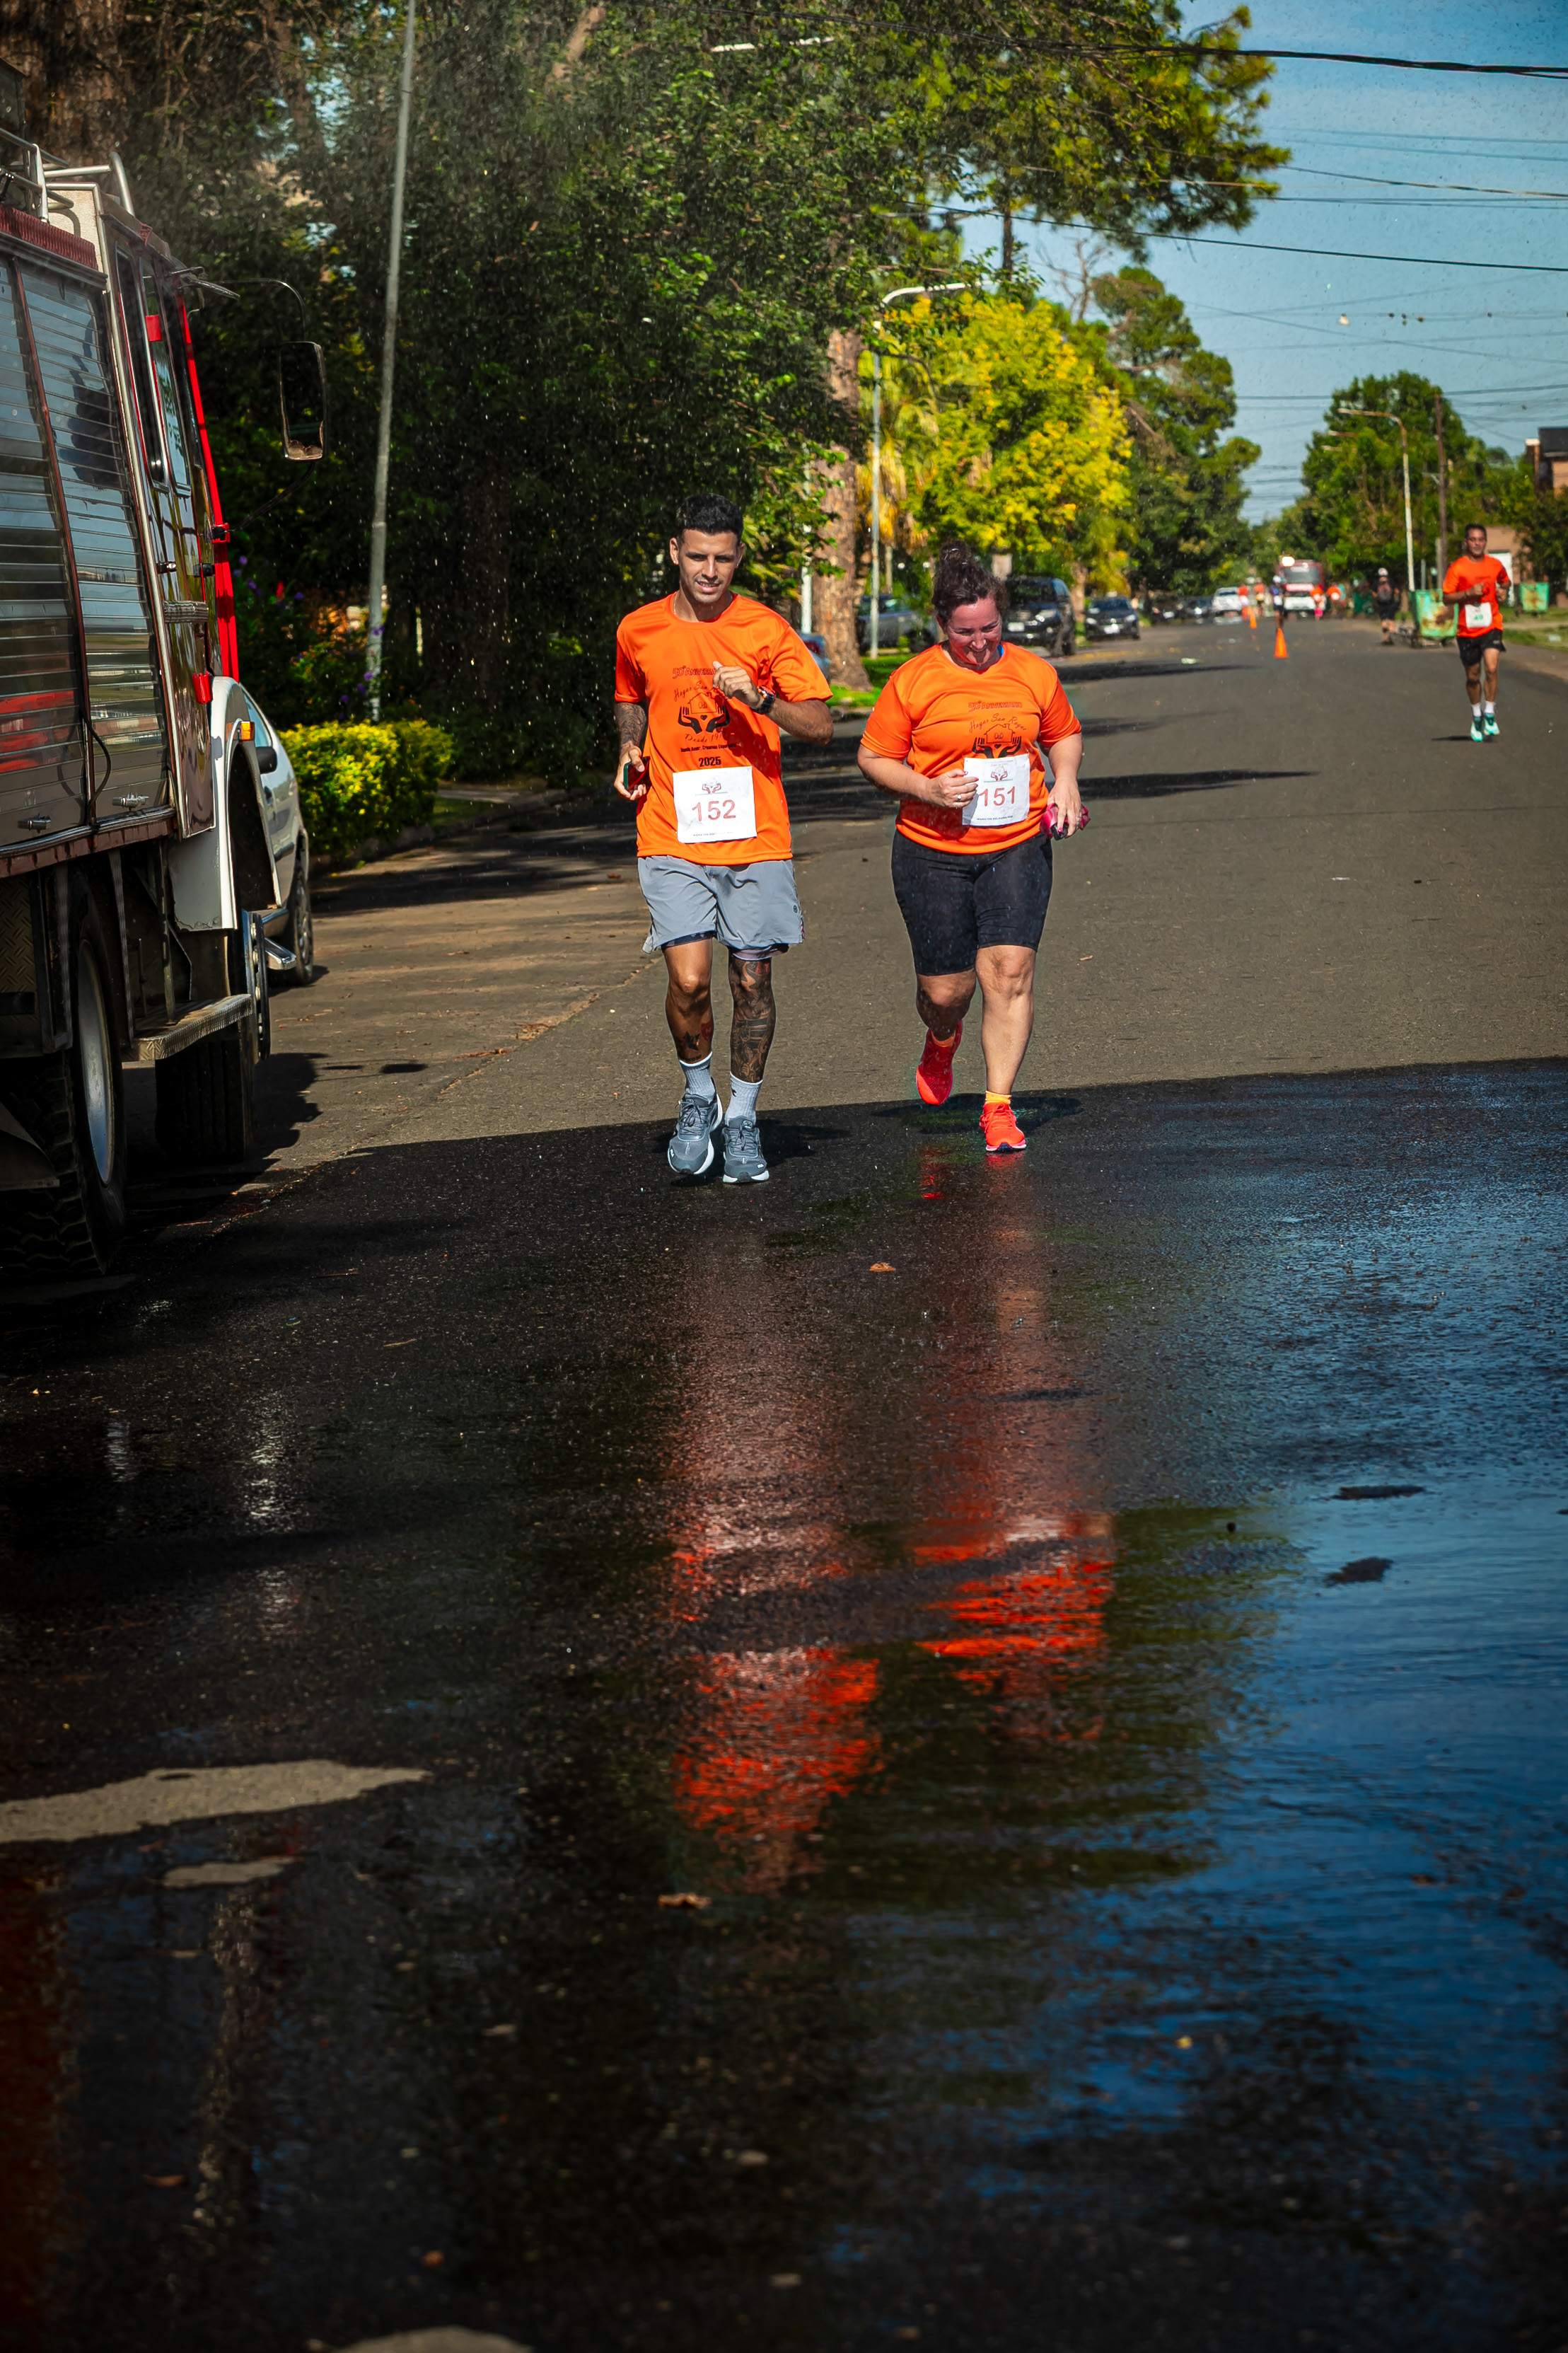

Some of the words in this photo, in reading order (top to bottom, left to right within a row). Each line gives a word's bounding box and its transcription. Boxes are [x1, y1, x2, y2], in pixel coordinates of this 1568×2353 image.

[685, 667, 716, 676] ANIVERSA
[699, 756, 721, 768] 2025
[979, 786, 1016, 807] 151
[692, 799, 736, 822] 152
